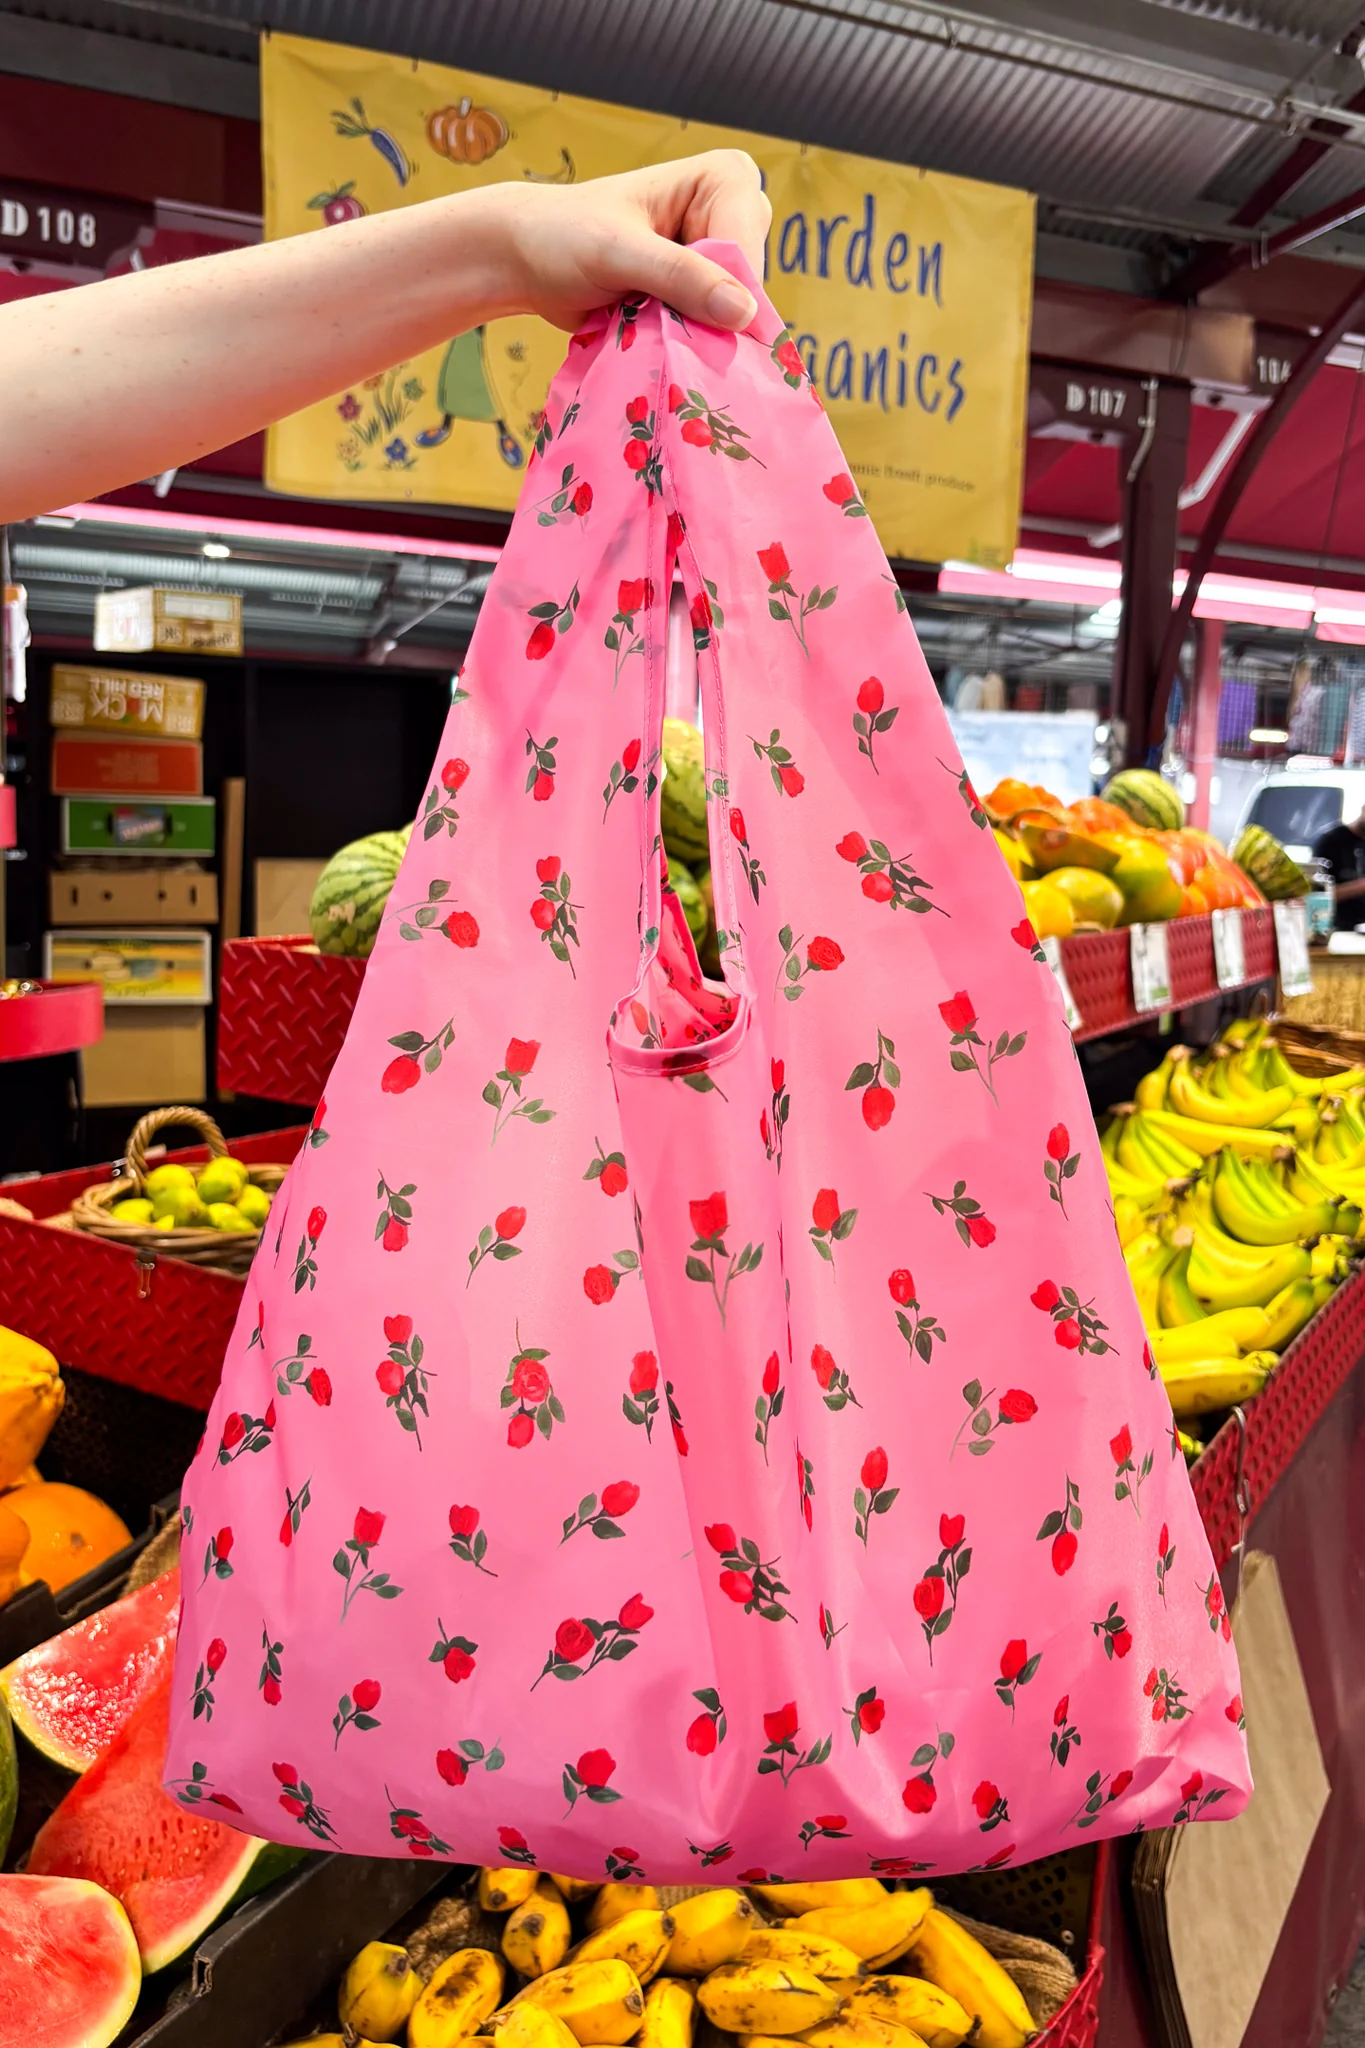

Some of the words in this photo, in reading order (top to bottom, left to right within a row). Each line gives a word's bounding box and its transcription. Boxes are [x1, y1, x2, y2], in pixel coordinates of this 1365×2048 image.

[0, 200, 29, 236] D
[37, 206, 96, 247] 108
[760, 168, 944, 308] arden
[1066, 383, 1086, 412] D
[1089, 387, 1126, 418] 107
[89, 677, 127, 696] HILL
[127, 681, 164, 700] RED
